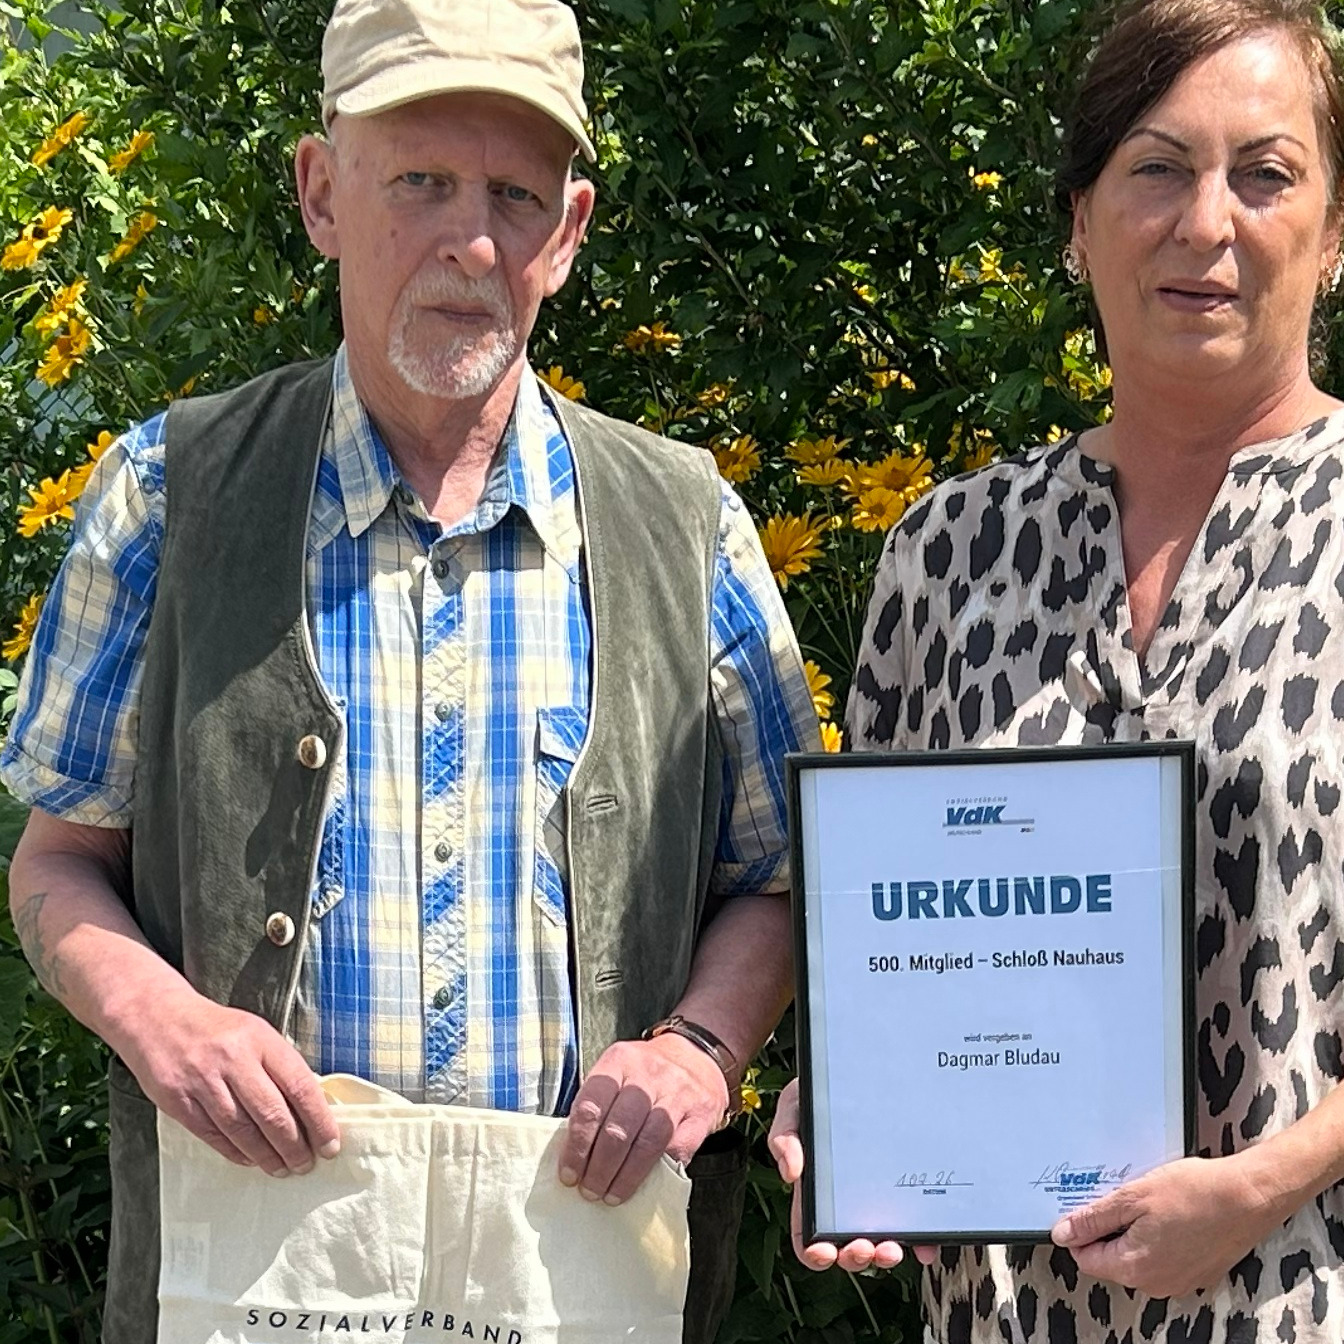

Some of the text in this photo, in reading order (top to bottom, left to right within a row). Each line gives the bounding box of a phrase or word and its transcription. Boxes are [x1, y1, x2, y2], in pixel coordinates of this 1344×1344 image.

[946, 805, 1006, 826] VdK
[871, 874, 1112, 921] URKUNDE
[868, 955, 904, 972] 500.
[909, 952, 974, 974] Mitglied
[992, 950, 1049, 968] Schloß
[1053, 947, 1124, 967] Nauhaus
[937, 1048, 1060, 1071] Dagmar Bludau
[1060, 1171, 1102, 1186] VdK
